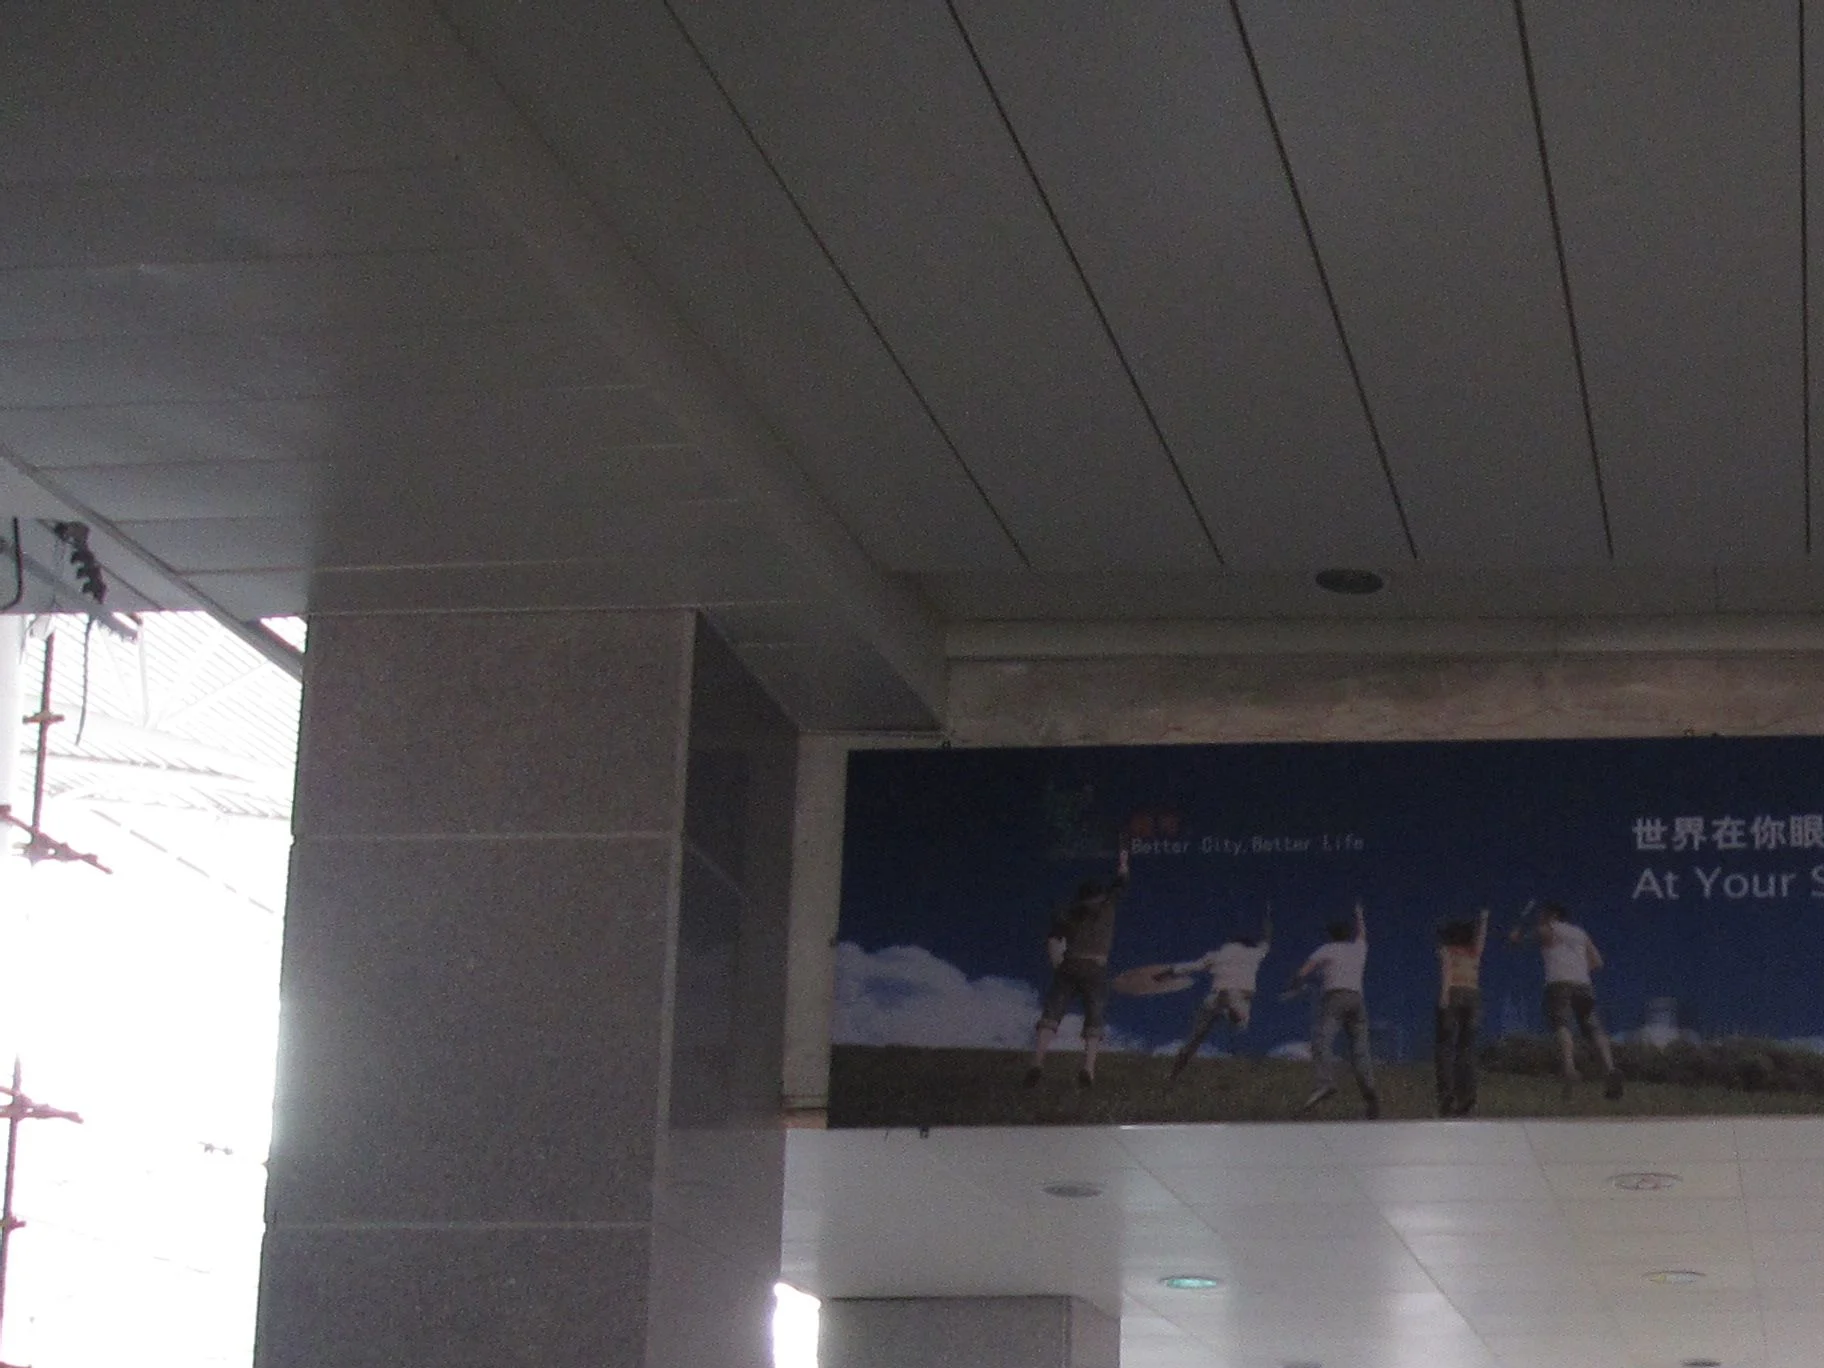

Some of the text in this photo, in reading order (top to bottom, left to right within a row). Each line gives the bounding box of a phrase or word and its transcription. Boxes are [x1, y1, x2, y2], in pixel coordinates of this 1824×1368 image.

[1130, 836, 1191, 854] Better
[1321, 832, 1365, 851] Life
[1632, 867, 1679, 899] At
[1696, 866, 1796, 899] Your
